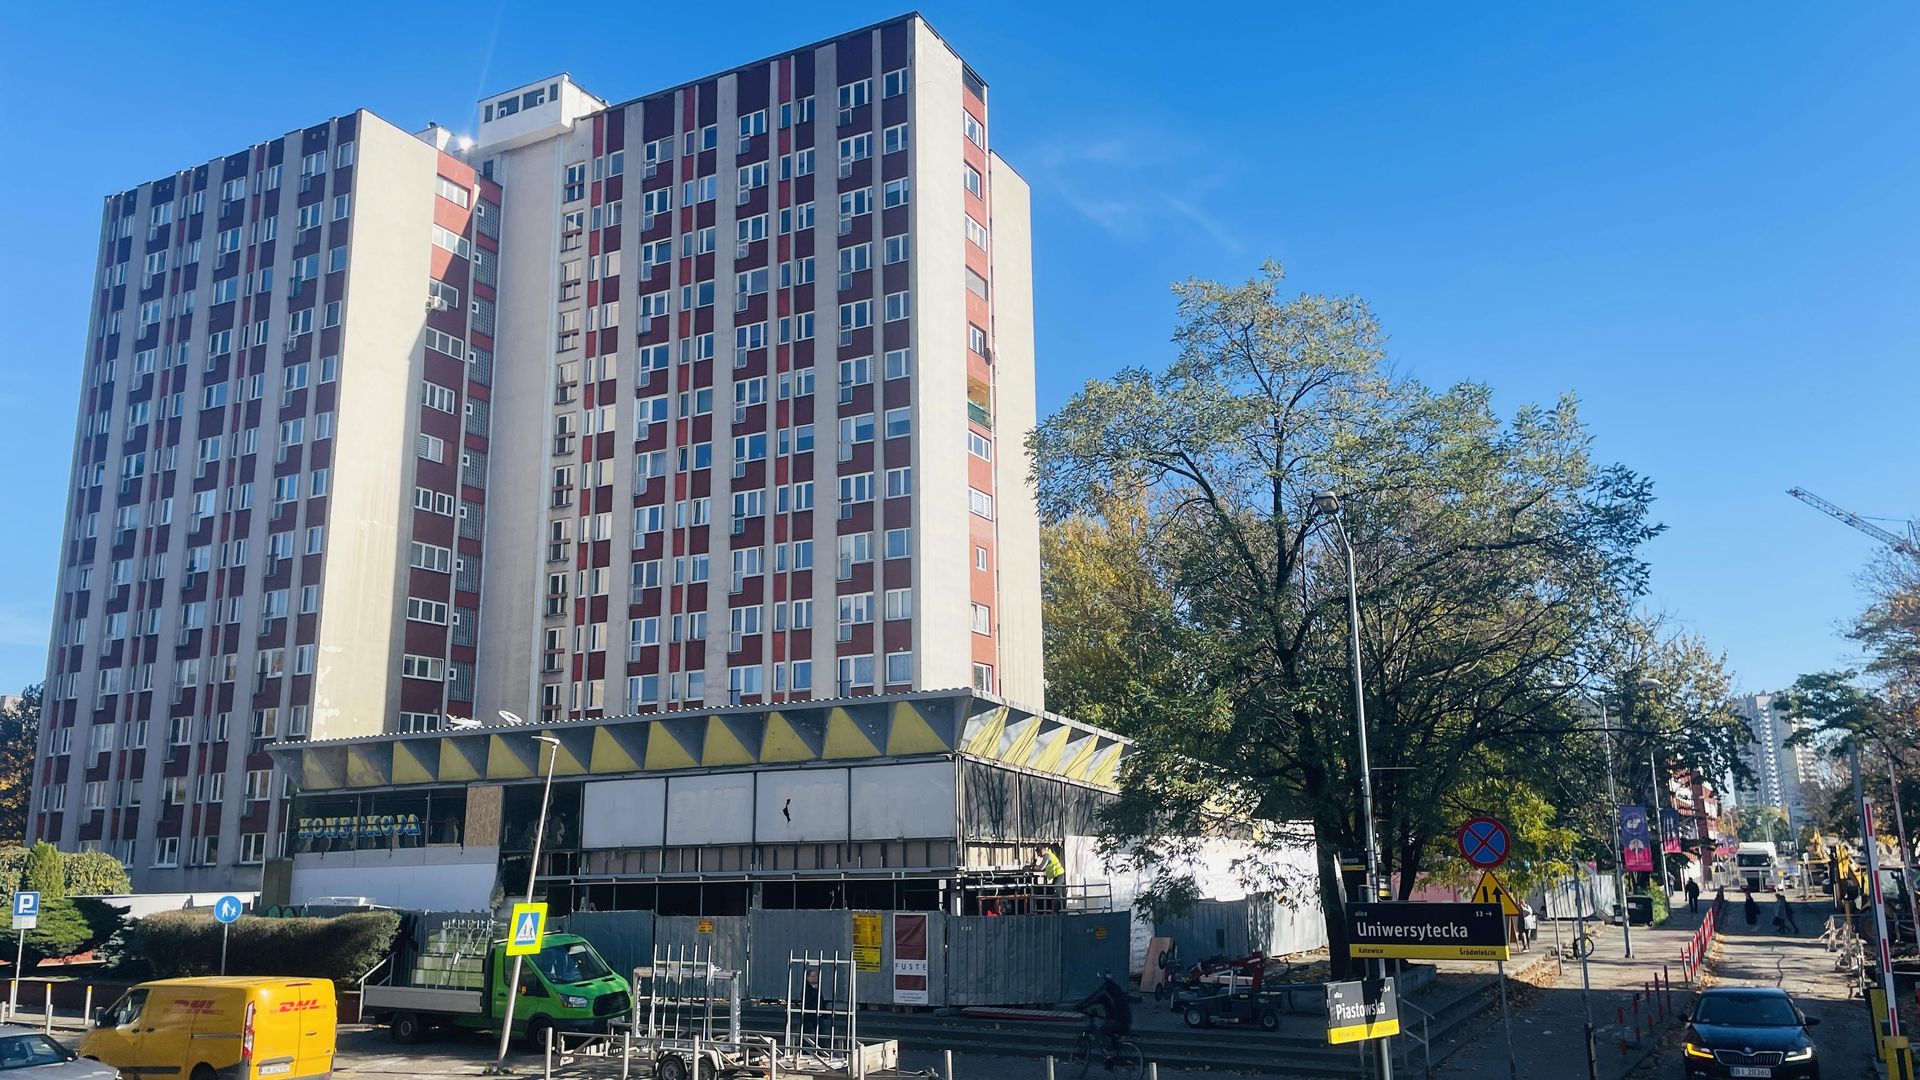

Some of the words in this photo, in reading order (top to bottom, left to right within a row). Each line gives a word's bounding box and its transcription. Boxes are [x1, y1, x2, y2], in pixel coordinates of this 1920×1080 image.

[19, 895, 34, 914] P
[1357, 921, 1468, 941] Uniwersytecka
[895, 962, 927, 970] FUSTE
[173, 1000, 217, 1014] DHL
[280, 999, 320, 1012] DHL
[1335, 998, 1386, 1020] Piastowska
